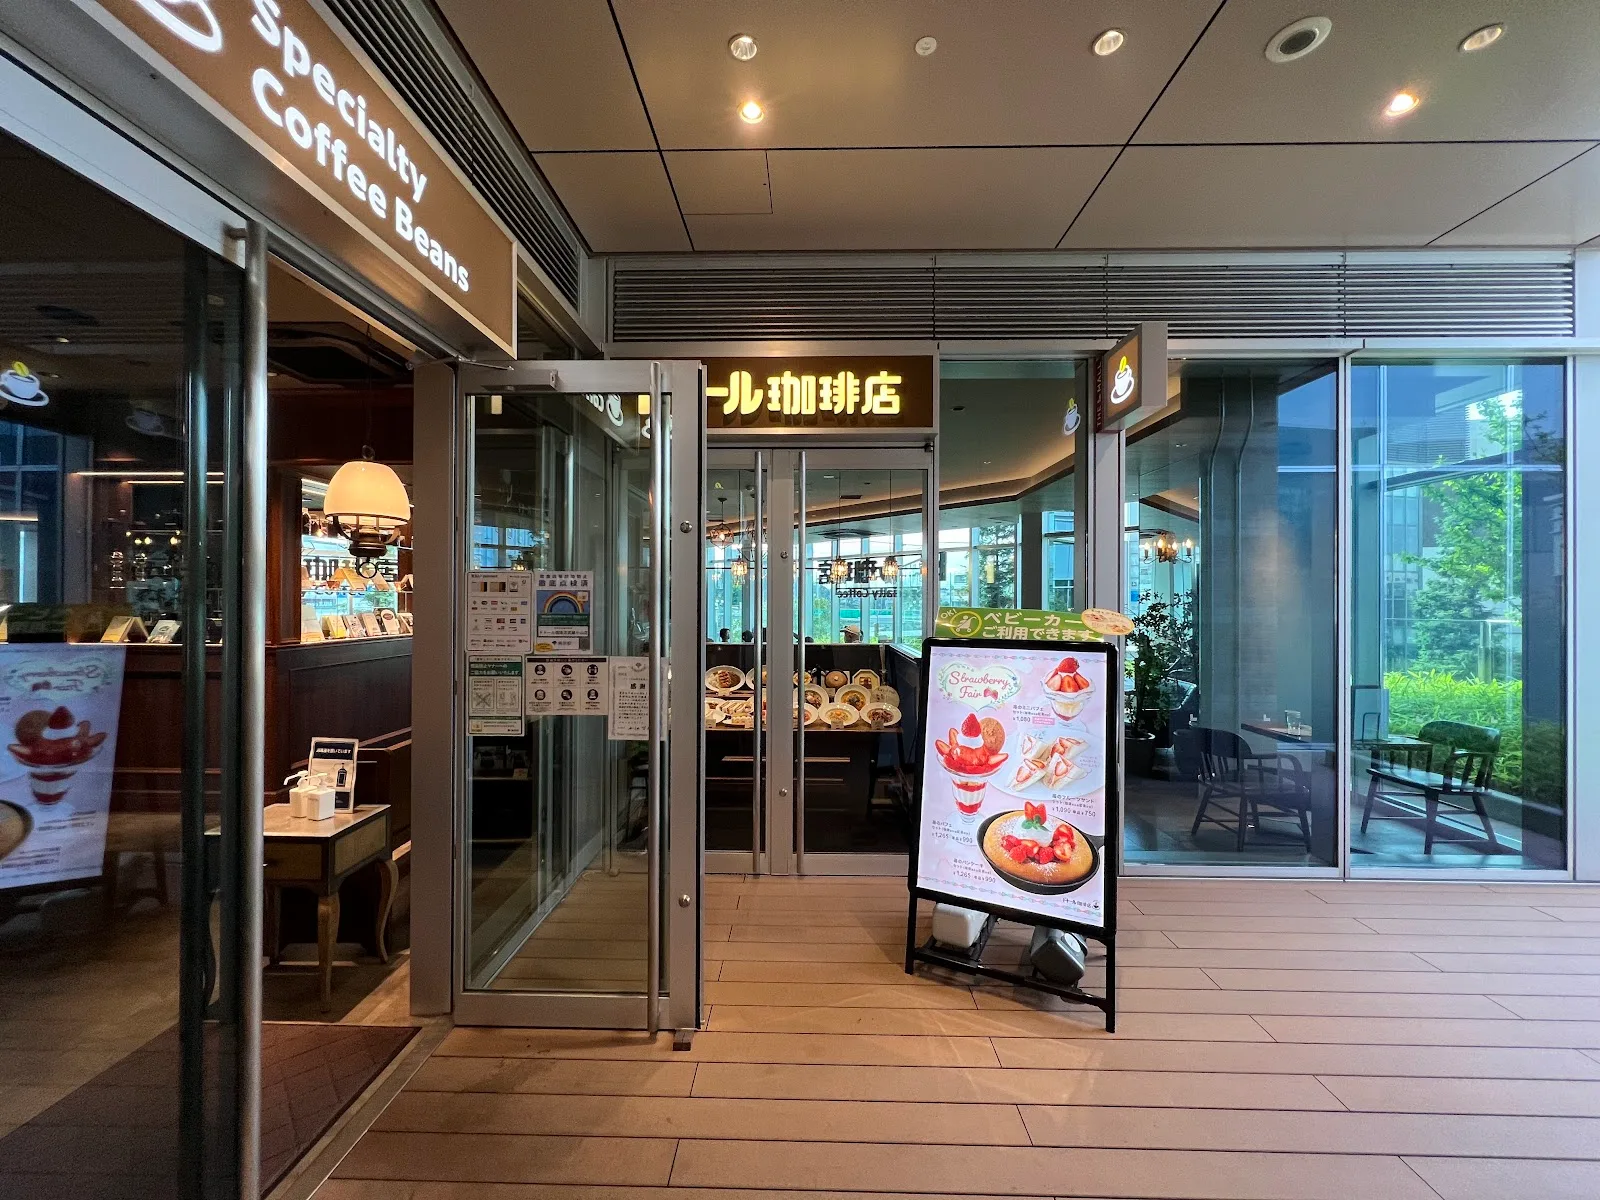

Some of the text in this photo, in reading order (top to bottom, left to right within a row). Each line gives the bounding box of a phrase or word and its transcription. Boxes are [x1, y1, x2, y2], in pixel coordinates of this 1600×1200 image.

[251, 0, 429, 204] Specialty
[251, 67, 470, 293] Coffee Beans
[940, 608, 957, 619] OK!
[983, 611, 1083, 626] ベビーカー
[982, 625, 1095, 641] ご利用できます
[949, 670, 1009, 690] Strawberry
[960, 685, 982, 699] Fair
